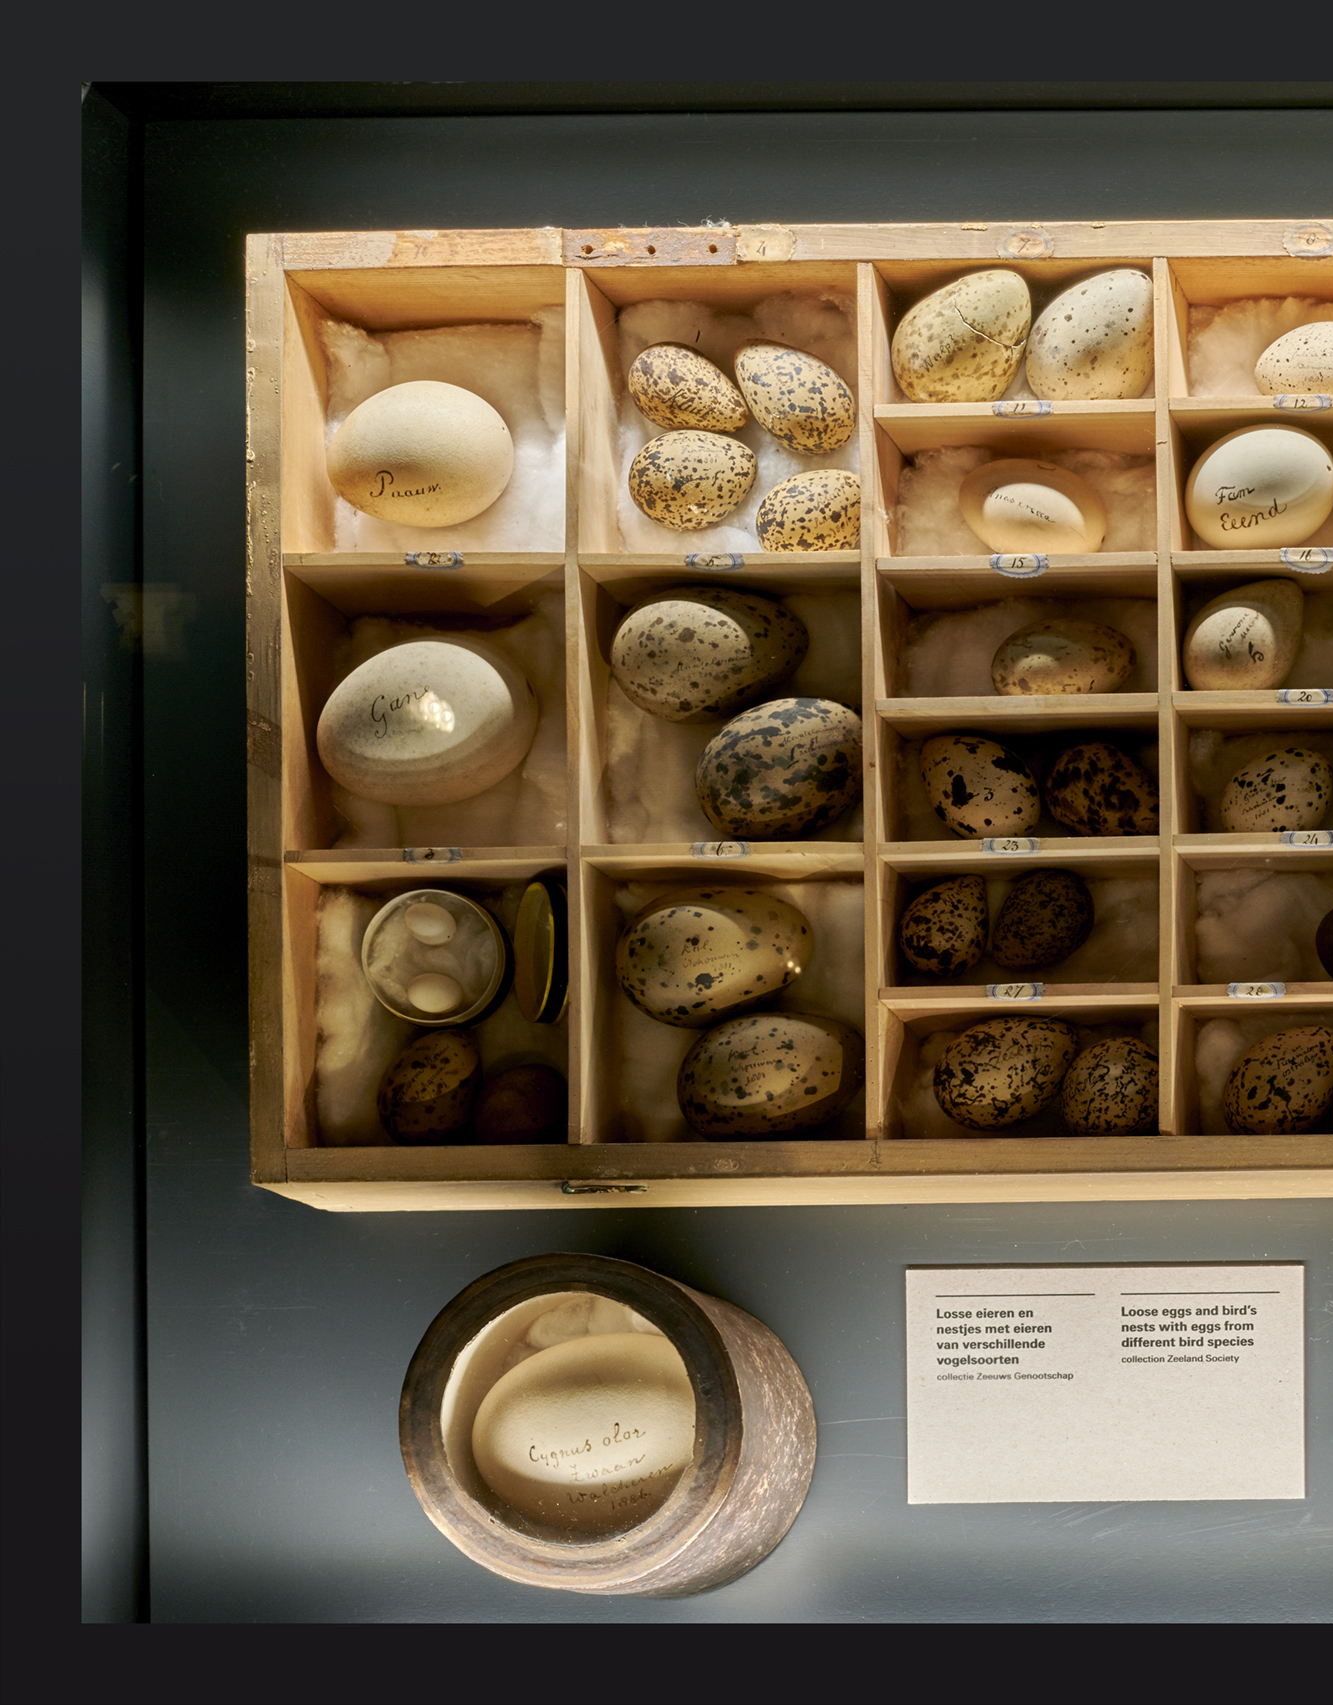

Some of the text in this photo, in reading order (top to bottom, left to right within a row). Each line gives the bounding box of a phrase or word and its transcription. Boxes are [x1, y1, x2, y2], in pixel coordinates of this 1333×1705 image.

[1011, 556, 1028, 569] 15
[1298, 691, 1312, 702] 20
[1002, 840, 1019, 852] 23
[937, 1308, 1034, 1320] Losse eieren en
[1121, 1306, 1158, 1317] Loose
[1162, 1308, 1192, 1320] eggs
[1195, 1305, 1218, 1317] and
[937, 1323, 1052, 1337] nestjes met eieren
[1121, 1320, 1254, 1335] nests with eggs from
[937, 1338, 1045, 1350] van verschillende
[1121, 1336, 1254, 1350] different bird species
[937, 1354, 1019, 1369] vogelsoorten
[1121, 1354, 1240, 1365] collection Zeeland Society
[937, 1371, 1074, 1383] collectie Zeeuws Genootschap
